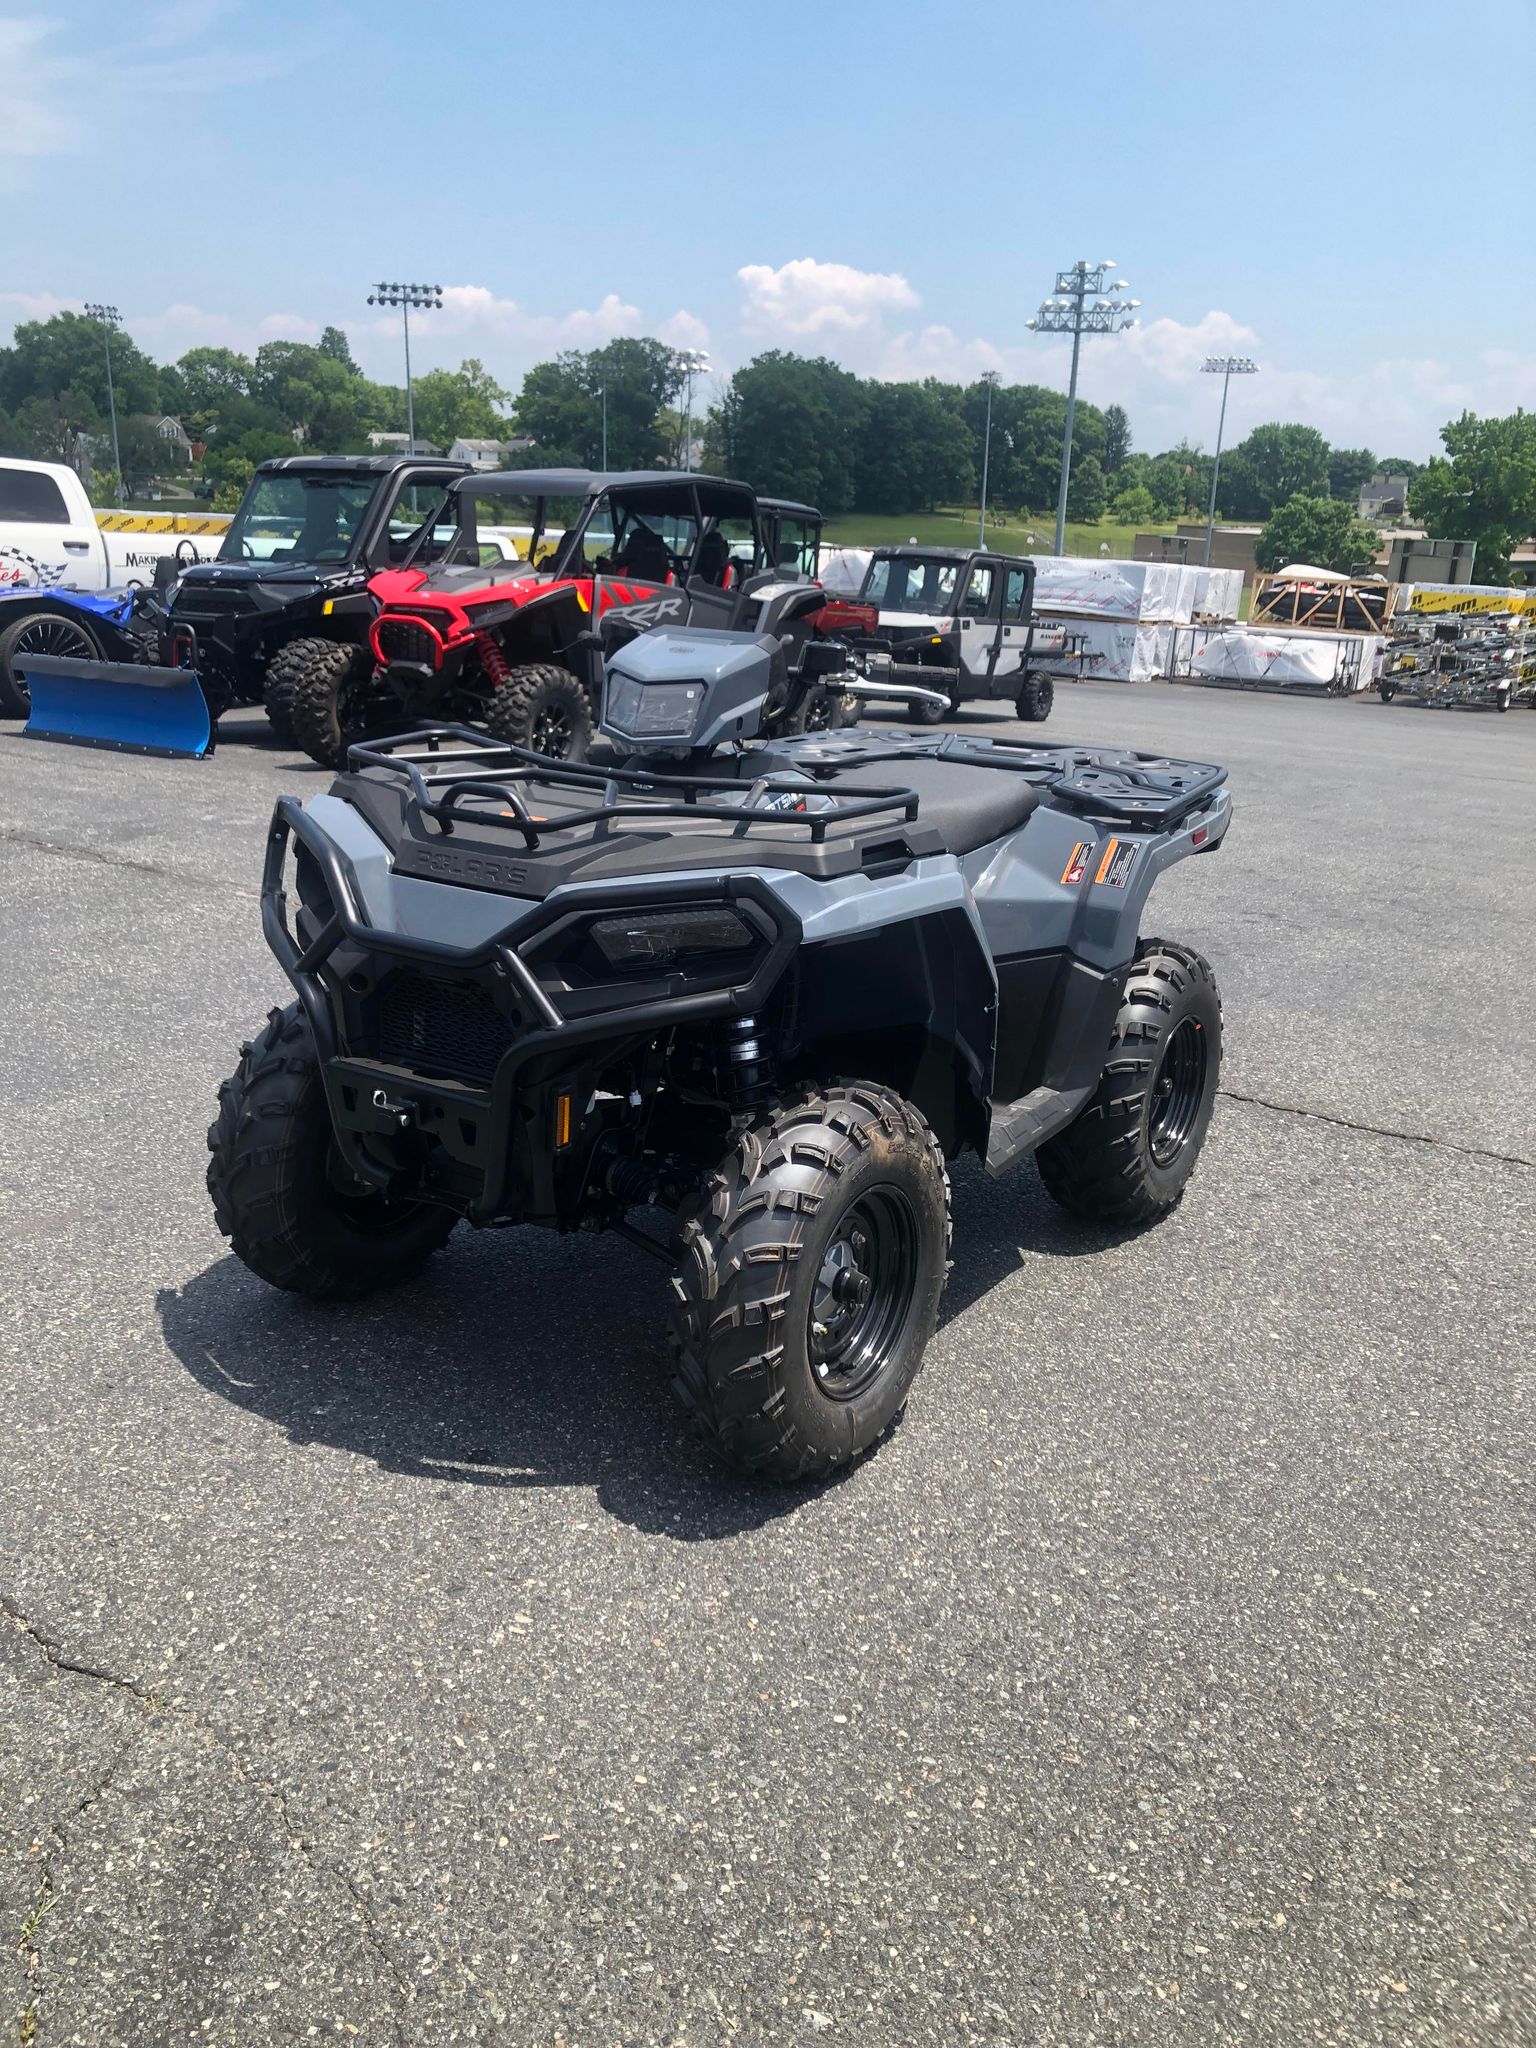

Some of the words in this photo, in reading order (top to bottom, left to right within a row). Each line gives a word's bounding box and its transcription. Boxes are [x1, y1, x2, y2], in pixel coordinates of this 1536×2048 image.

[126, 552, 159, 567] MAKIN
[328, 575, 366, 590] XP
[601, 598, 682, 623] RZR
[417, 850, 528, 886] POLARIS
